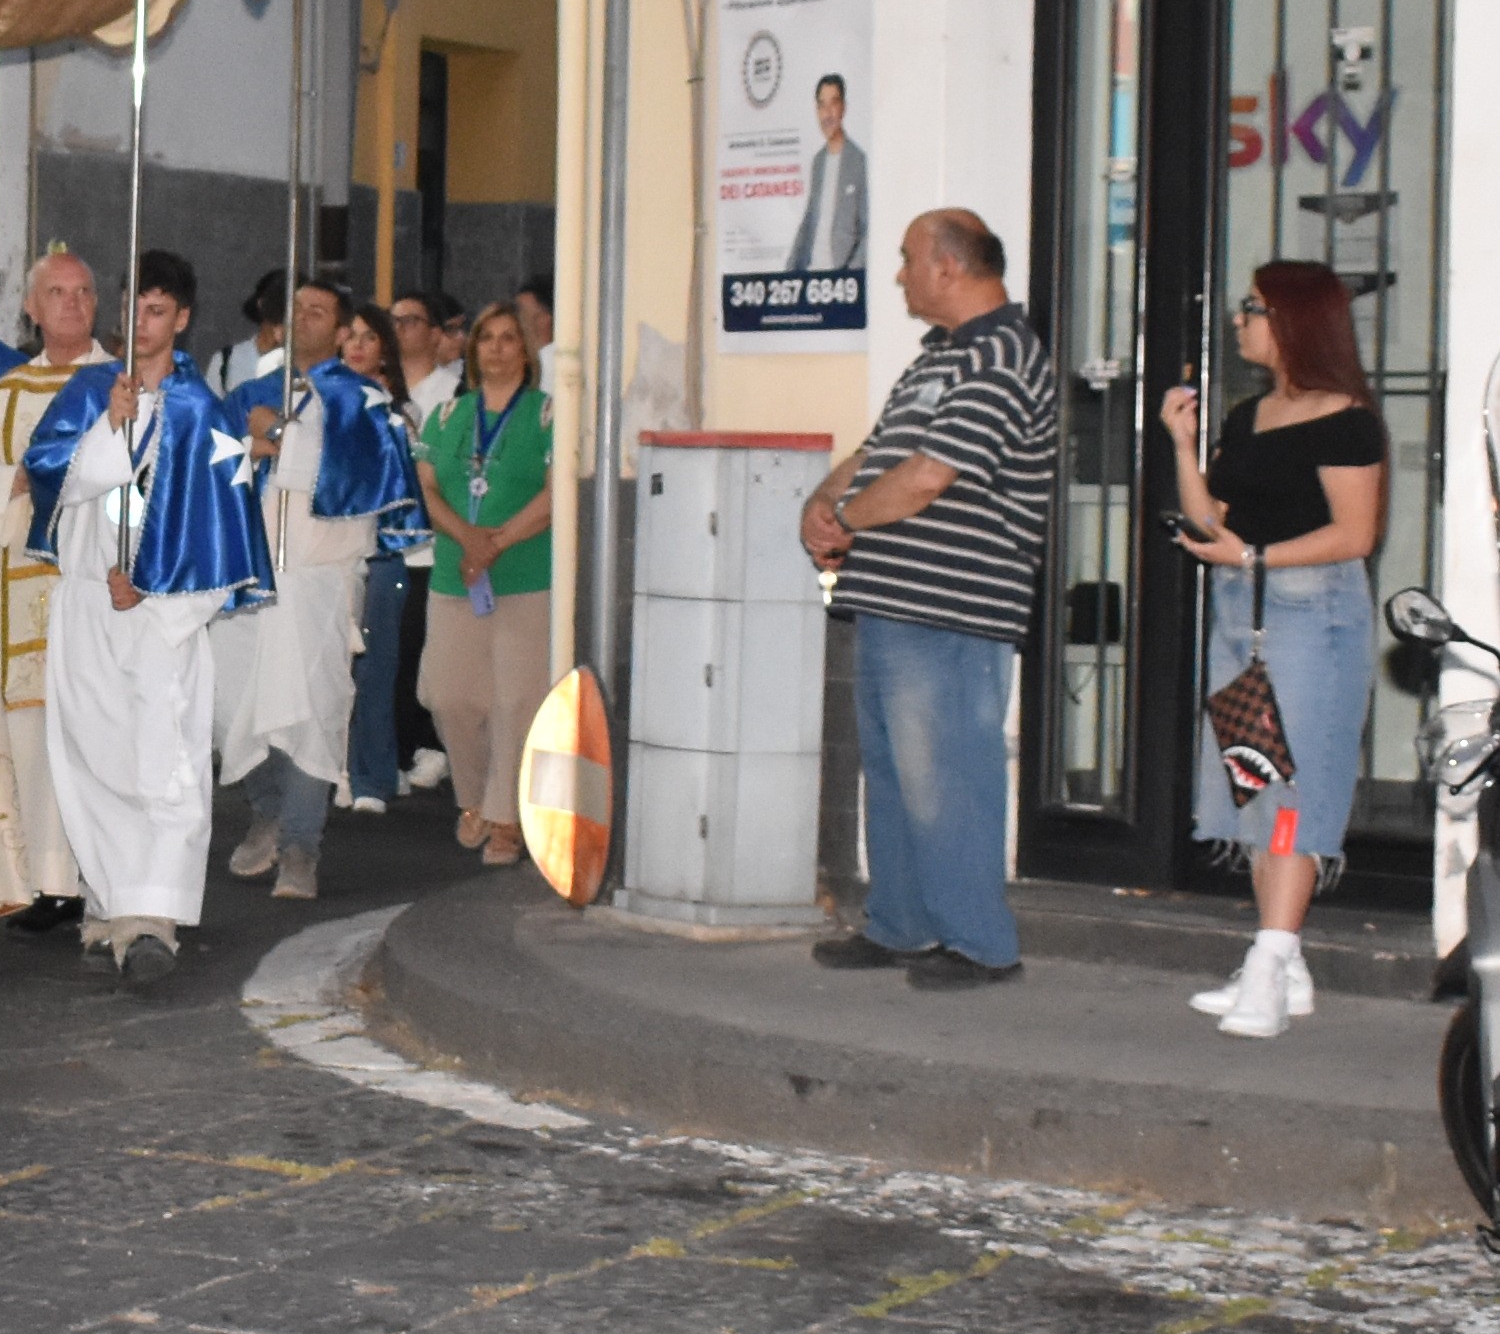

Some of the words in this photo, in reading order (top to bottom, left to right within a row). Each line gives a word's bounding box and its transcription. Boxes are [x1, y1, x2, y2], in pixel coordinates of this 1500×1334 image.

[1228, 67, 1398, 187] sky
[729, 280, 765, 308] 340
[768, 279, 803, 306] 267
[805, 277, 859, 305] 6849
